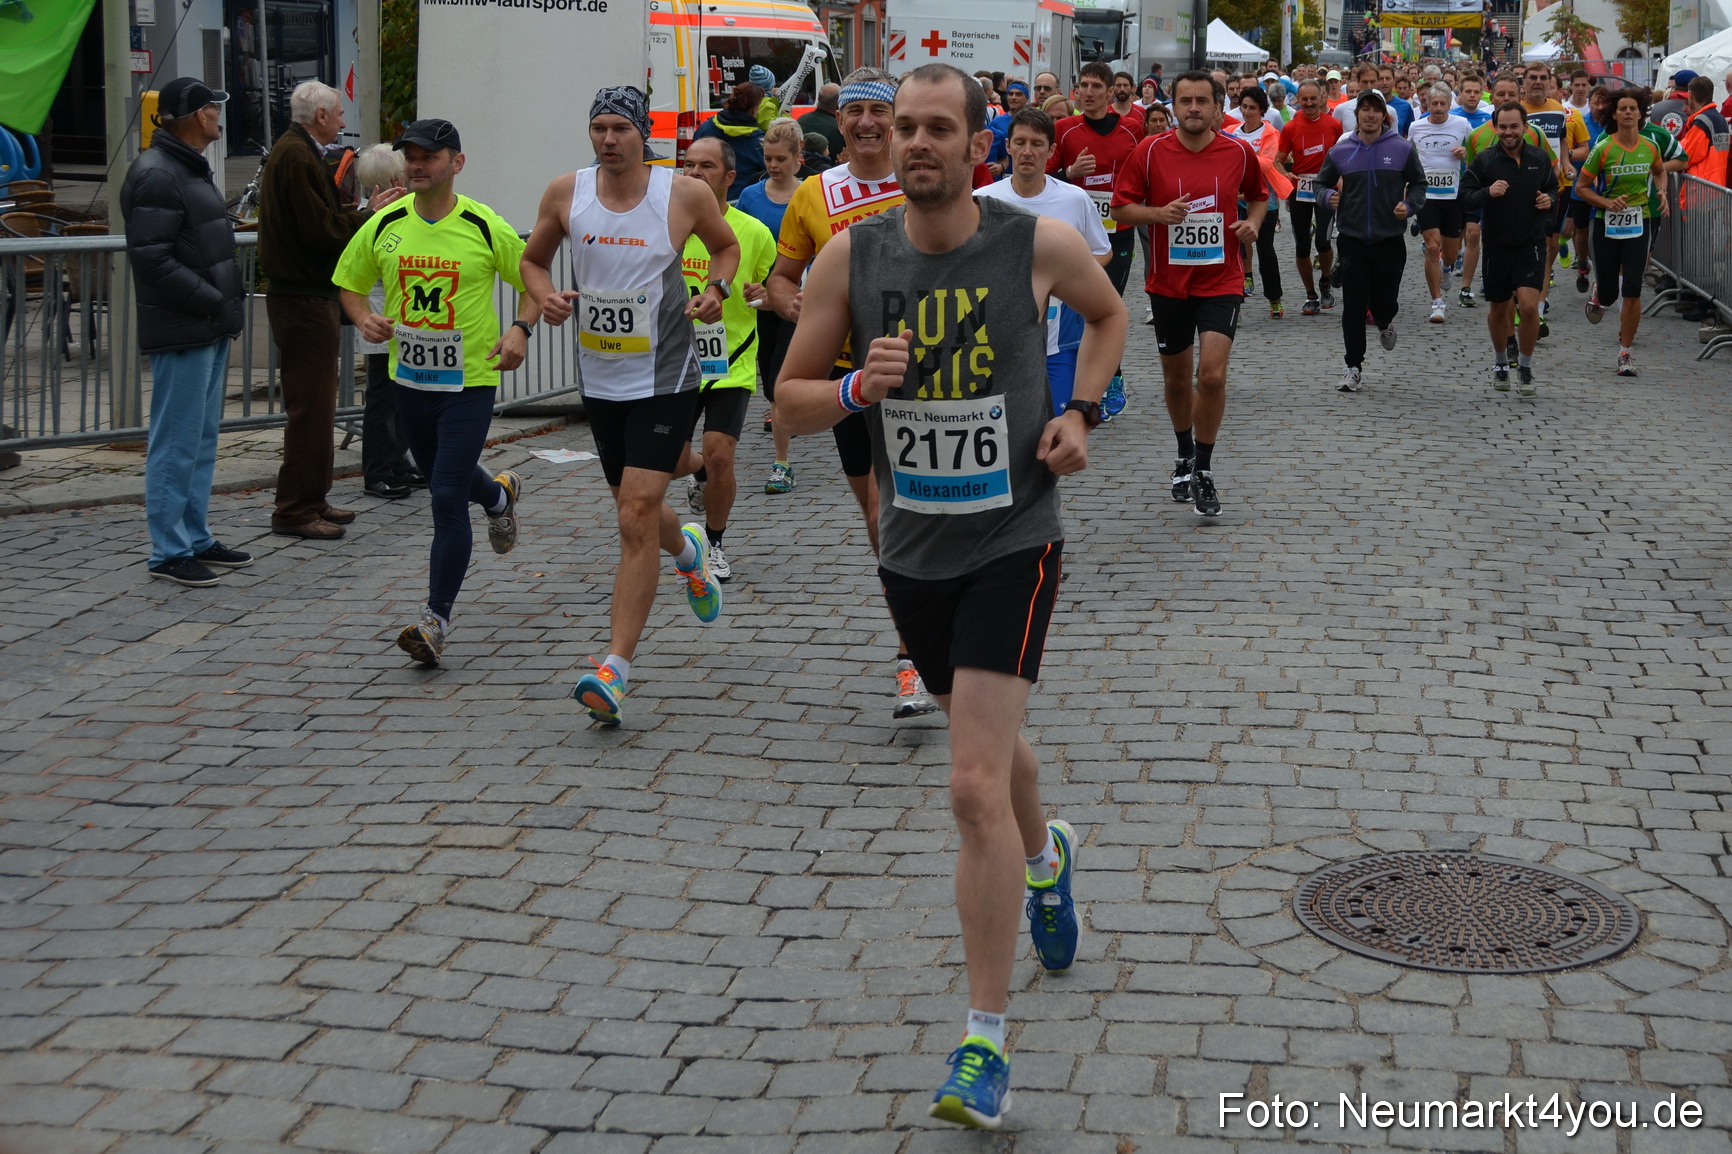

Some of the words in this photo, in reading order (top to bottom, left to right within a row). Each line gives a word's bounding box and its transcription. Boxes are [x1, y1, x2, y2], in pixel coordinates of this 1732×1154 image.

[1412, 16, 1448, 26] START
[951, 30, 1000, 40] Bayerisches
[951, 40, 974, 49] Rotes
[950, 50, 974, 59] Kreuz
[1209, 51, 1242, 60] Laufsport
[722, 55, 745, 68] Bayerisches
[1611, 163, 1650, 176] BOCK
[1300, 179, 1313, 192] 21
[1427, 175, 1453, 187] 3043
[1608, 212, 1638, 227] 2791
[598, 236, 648, 247] KLEBL
[1174, 225, 1219, 245] 2568
[1186, 249, 1207, 258] Adolf
[398, 255, 462, 270] Müller
[411, 285, 443, 313] M
[596, 296, 635, 305] Neumarkt
[588, 305, 634, 334] 239
[881, 287, 989, 345] RUN
[395, 329, 415, 340] PARTL
[415, 334, 450, 343] Neumarkt
[600, 339, 622, 351] Uwe
[698, 337, 722, 358] 90
[400, 340, 458, 368] 2818
[701, 363, 716, 374] ang
[913, 345, 995, 399] HIS
[415, 371, 439, 382] Mike
[884, 408, 922, 422] PARTL
[924, 411, 984, 423] Neumarkt
[896, 426, 998, 470] 2176
[908, 480, 989, 498] Alexander
